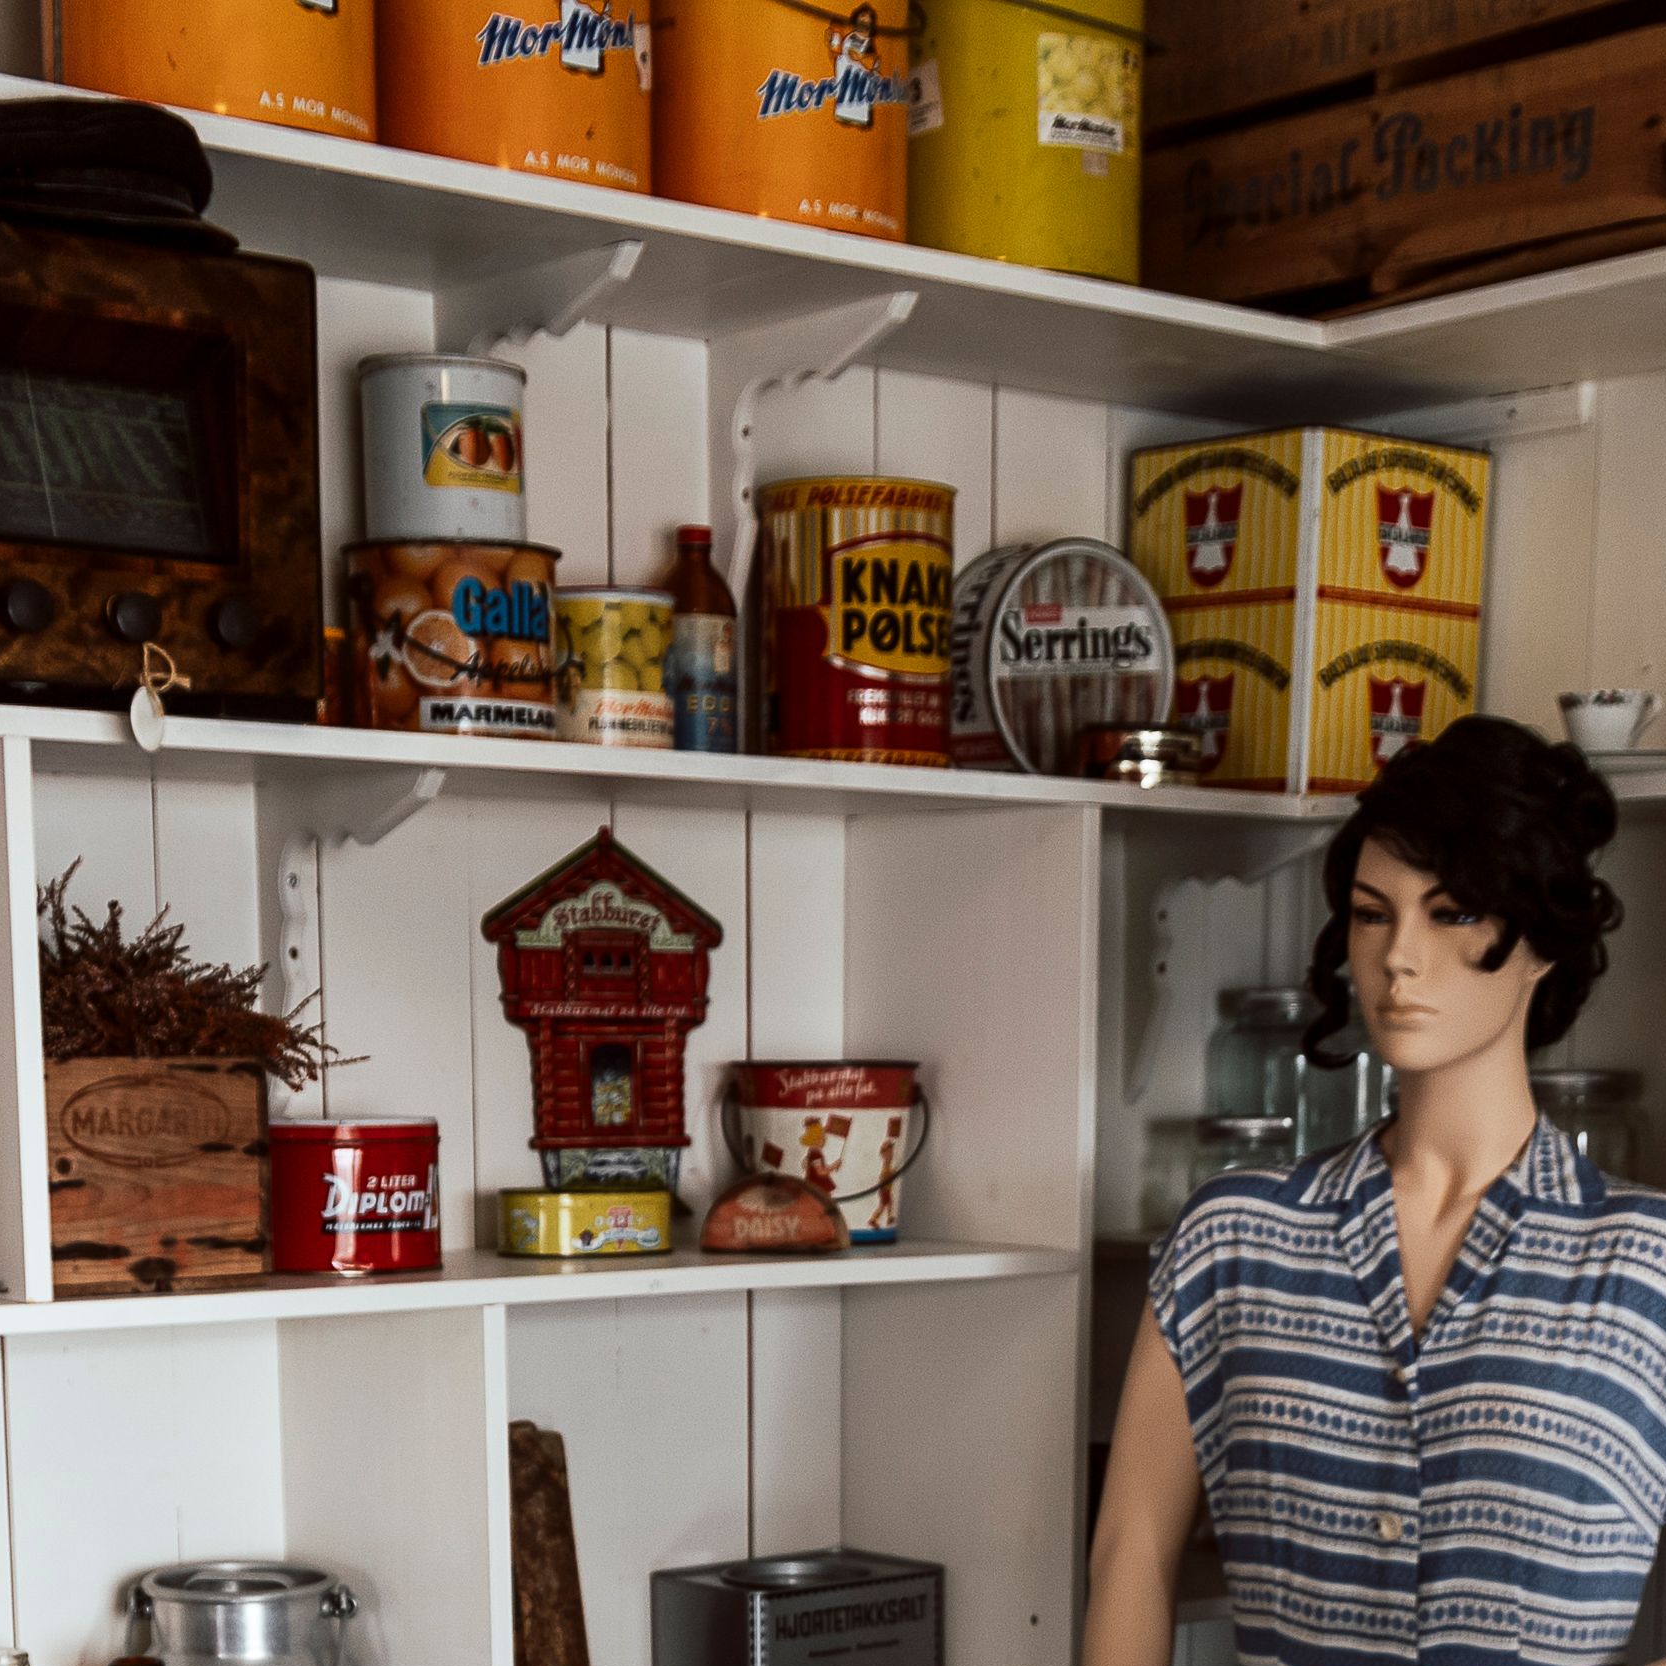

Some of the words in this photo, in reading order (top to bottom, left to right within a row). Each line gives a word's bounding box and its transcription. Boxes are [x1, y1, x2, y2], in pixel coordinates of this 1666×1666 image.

[293, 95, 326, 118] MOR
[556, 153, 590, 173] MOR
[1372, 103, 1597, 203] Packing
[999, 609, 1152, 674] Serrings
[367, 1174, 378, 1188] 2
[380, 1174, 417, 1188] LITER
[774, 1594, 928, 1642] HJORTETAKKSALT
